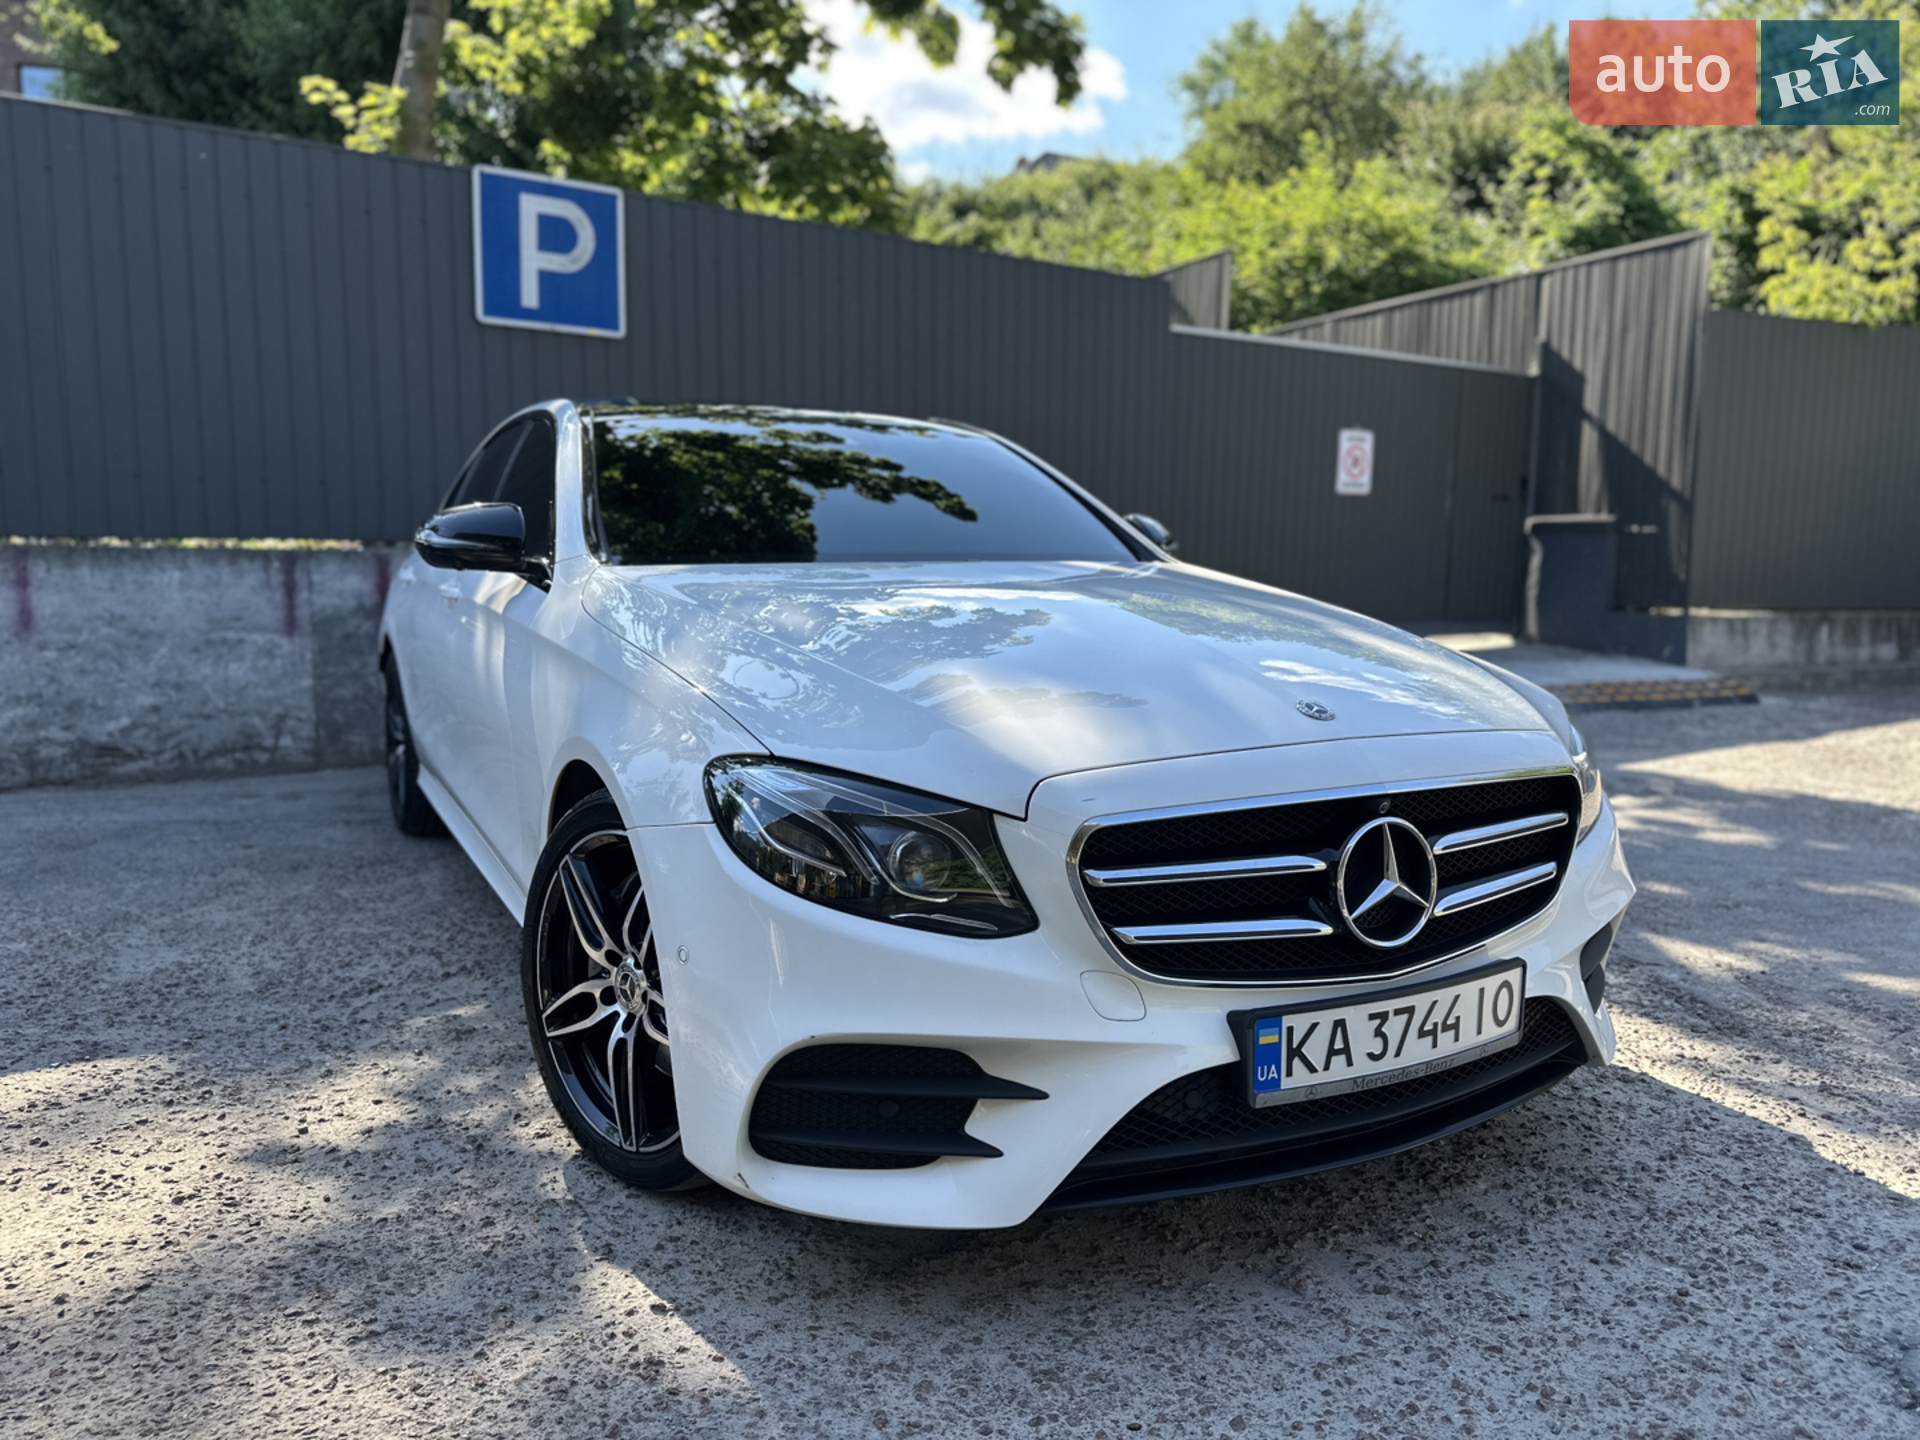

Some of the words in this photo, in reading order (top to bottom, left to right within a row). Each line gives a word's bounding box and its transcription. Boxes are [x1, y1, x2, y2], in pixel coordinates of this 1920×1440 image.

[519, 191, 597, 310] P
[1285, 1017, 1354, 1078] KA
[1366, 993, 1461, 1063] 3744
[1257, 1064, 1278, 1082] UA
[1351, 1057, 1456, 1092] Mercedes-Benz
